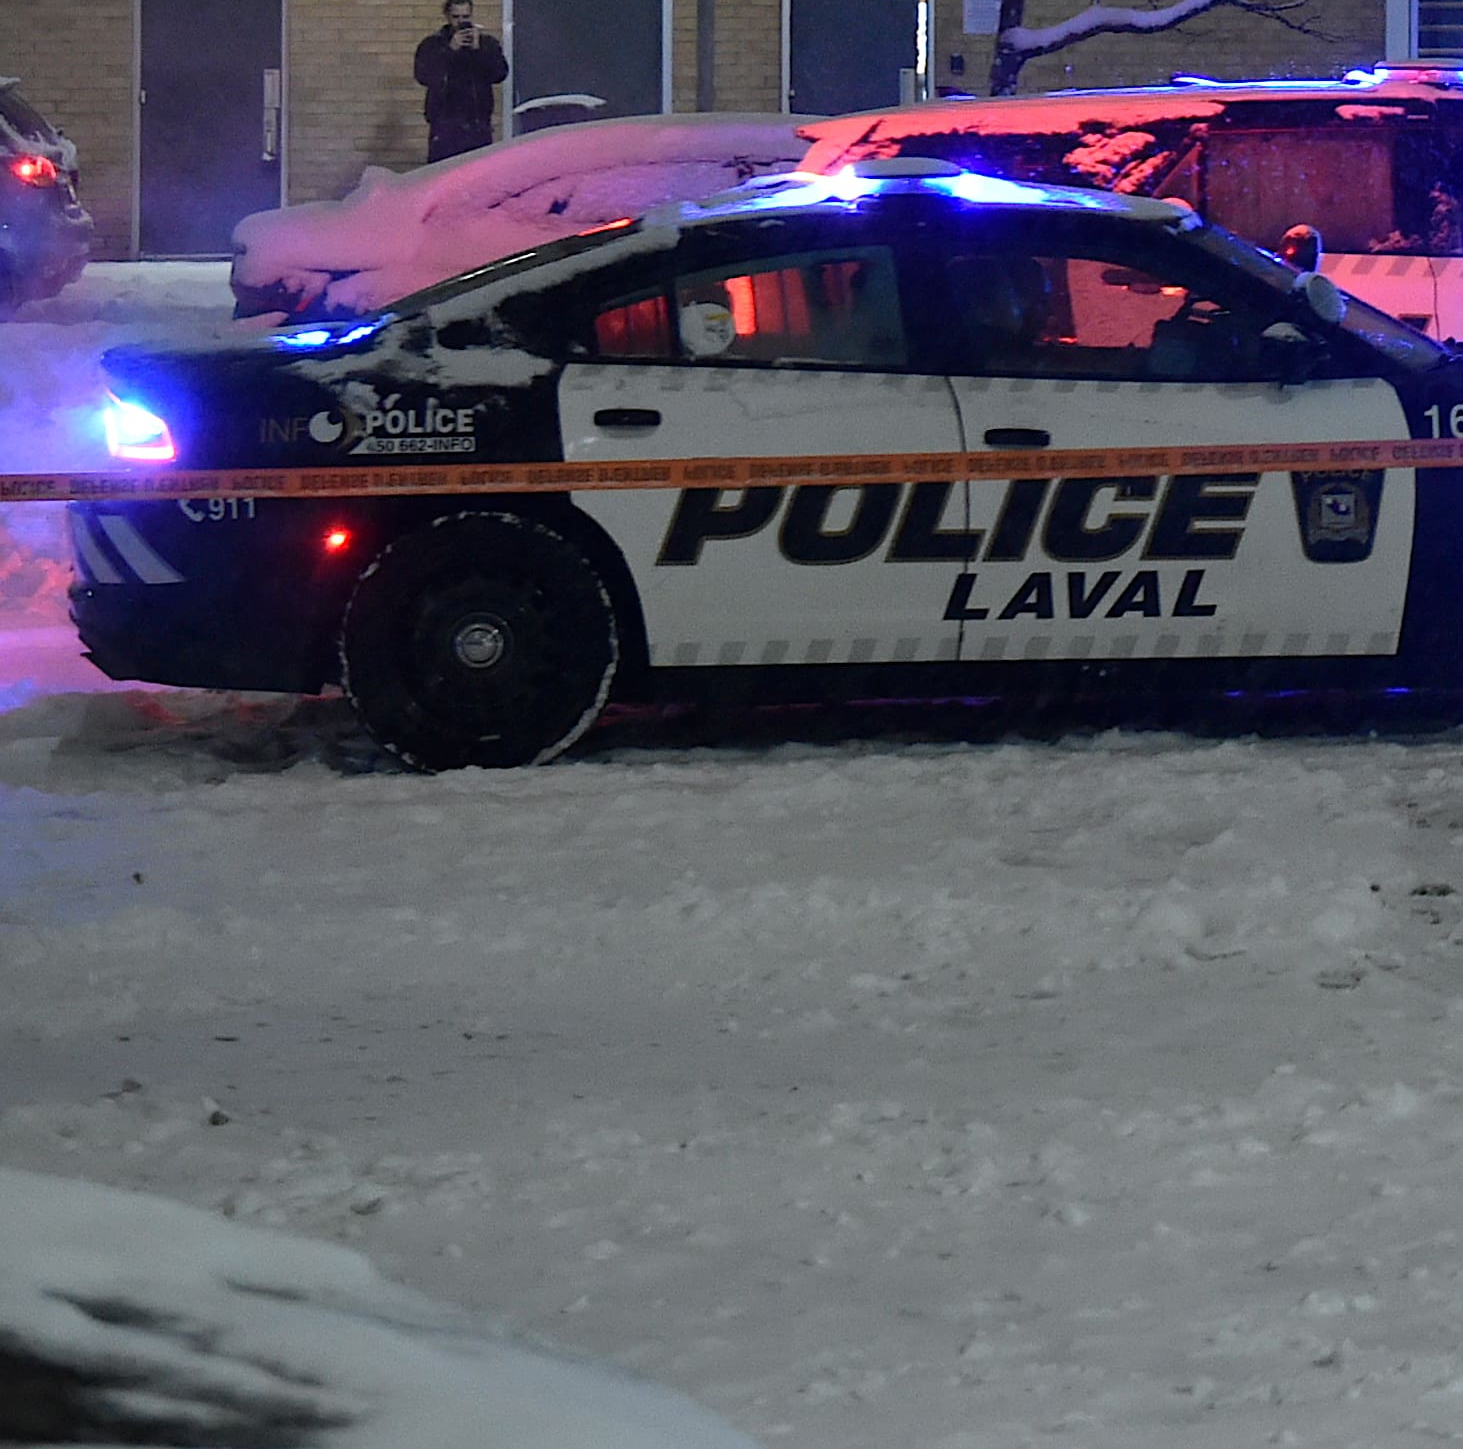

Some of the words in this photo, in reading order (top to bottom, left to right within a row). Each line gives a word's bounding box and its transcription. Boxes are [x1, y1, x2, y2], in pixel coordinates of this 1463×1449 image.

[365, 408, 475, 434] POLICE
[208, 497, 255, 520] 911
[655, 473, 1262, 566] POLICE
[943, 568, 1217, 621] LAVAL
